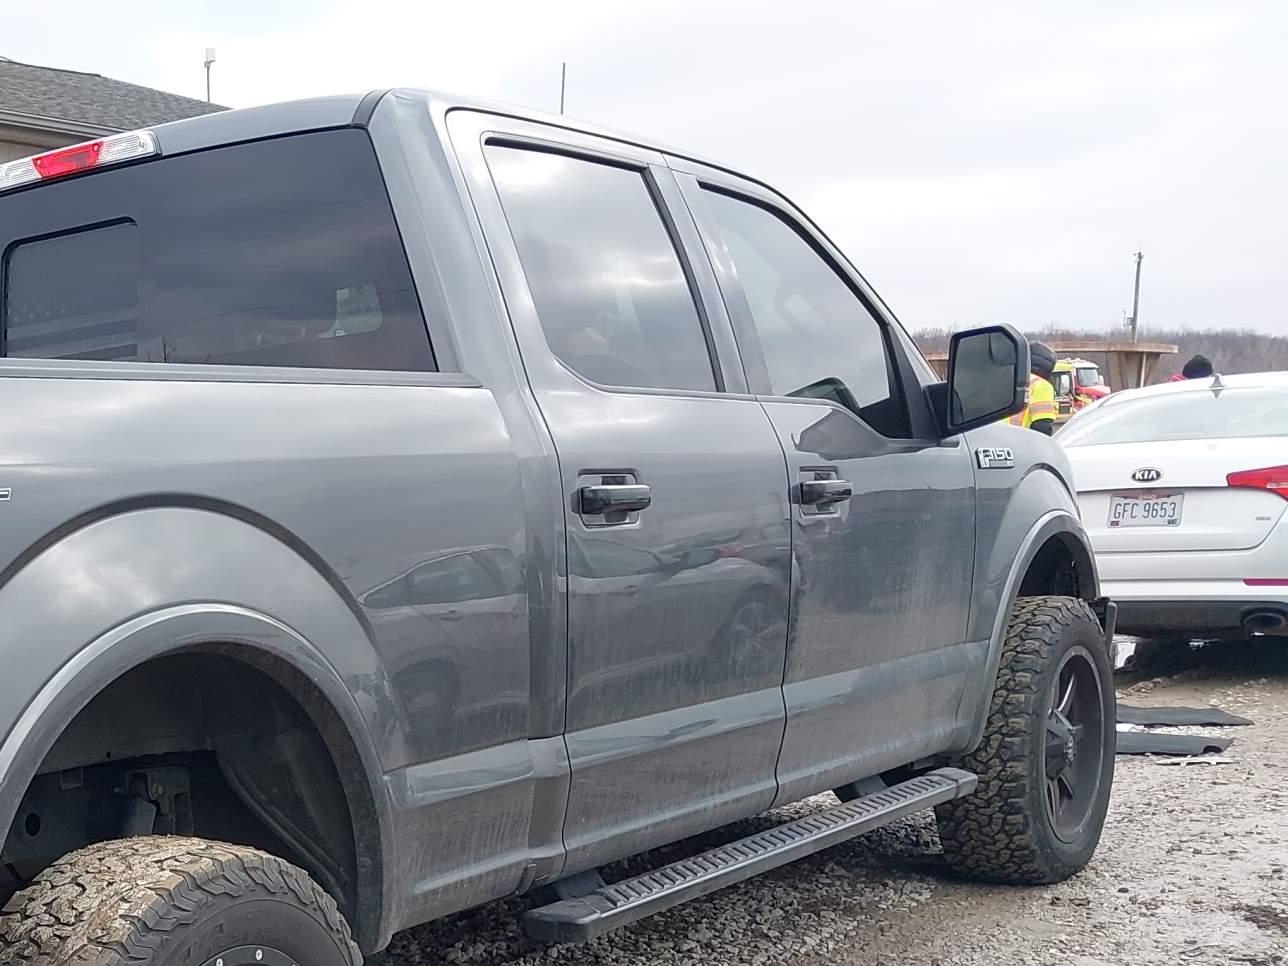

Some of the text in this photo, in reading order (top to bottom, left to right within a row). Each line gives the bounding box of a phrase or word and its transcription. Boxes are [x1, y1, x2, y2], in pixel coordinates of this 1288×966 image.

[1135, 470, 1157, 480] KIA
[1113, 501, 1177, 519] GFC 9653
